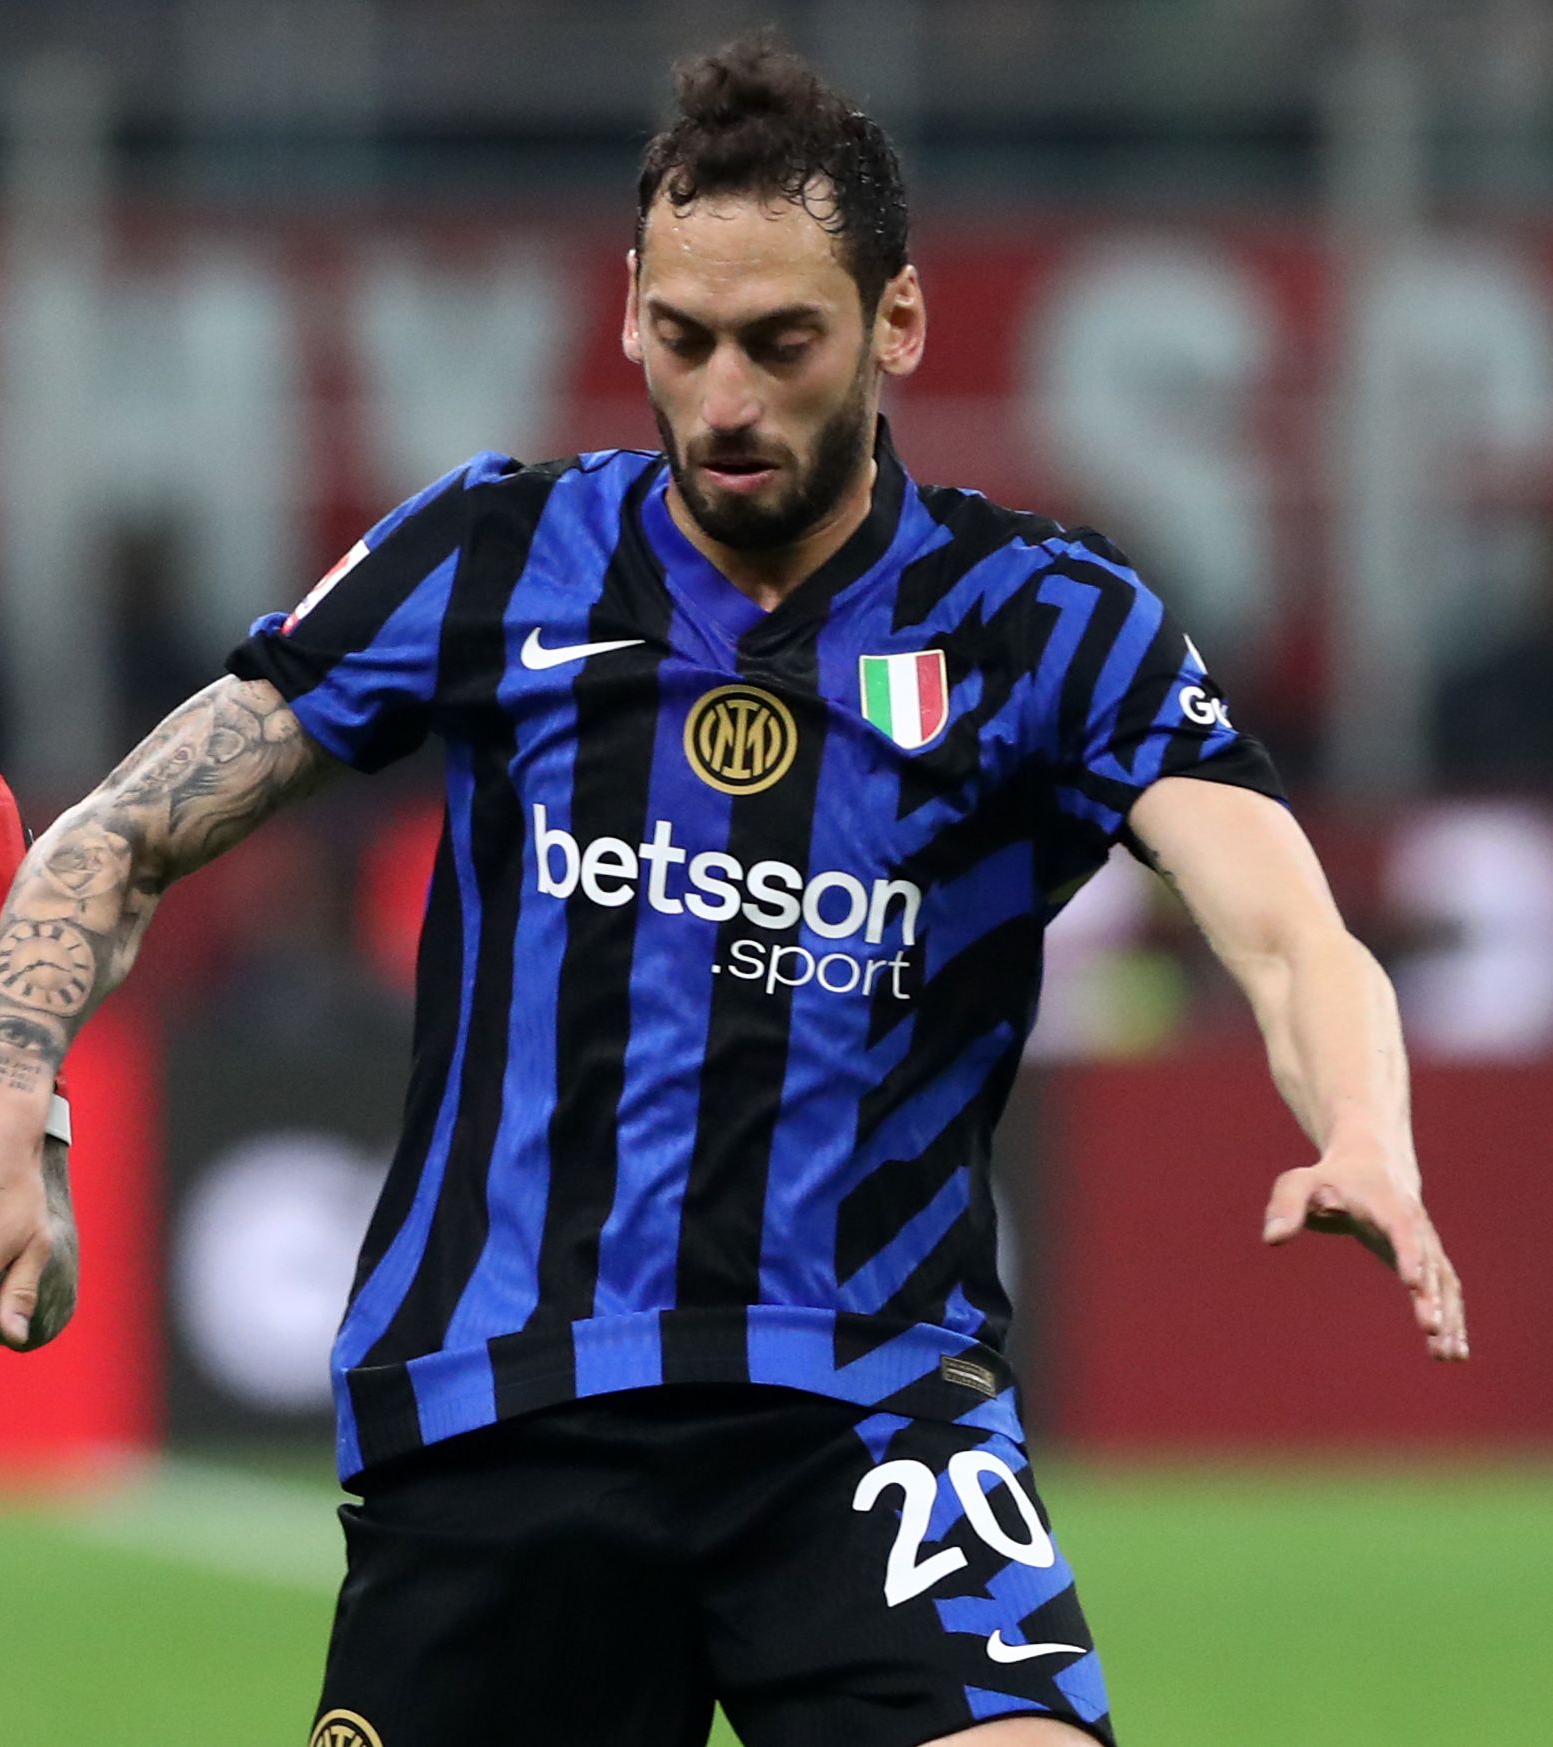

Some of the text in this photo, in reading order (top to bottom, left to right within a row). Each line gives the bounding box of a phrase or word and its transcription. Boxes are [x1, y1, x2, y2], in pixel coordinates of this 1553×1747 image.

[532, 803, 923, 946] betsson
[710, 939, 911, 1000] .sport
[851, 1449, 1056, 1608] 20
